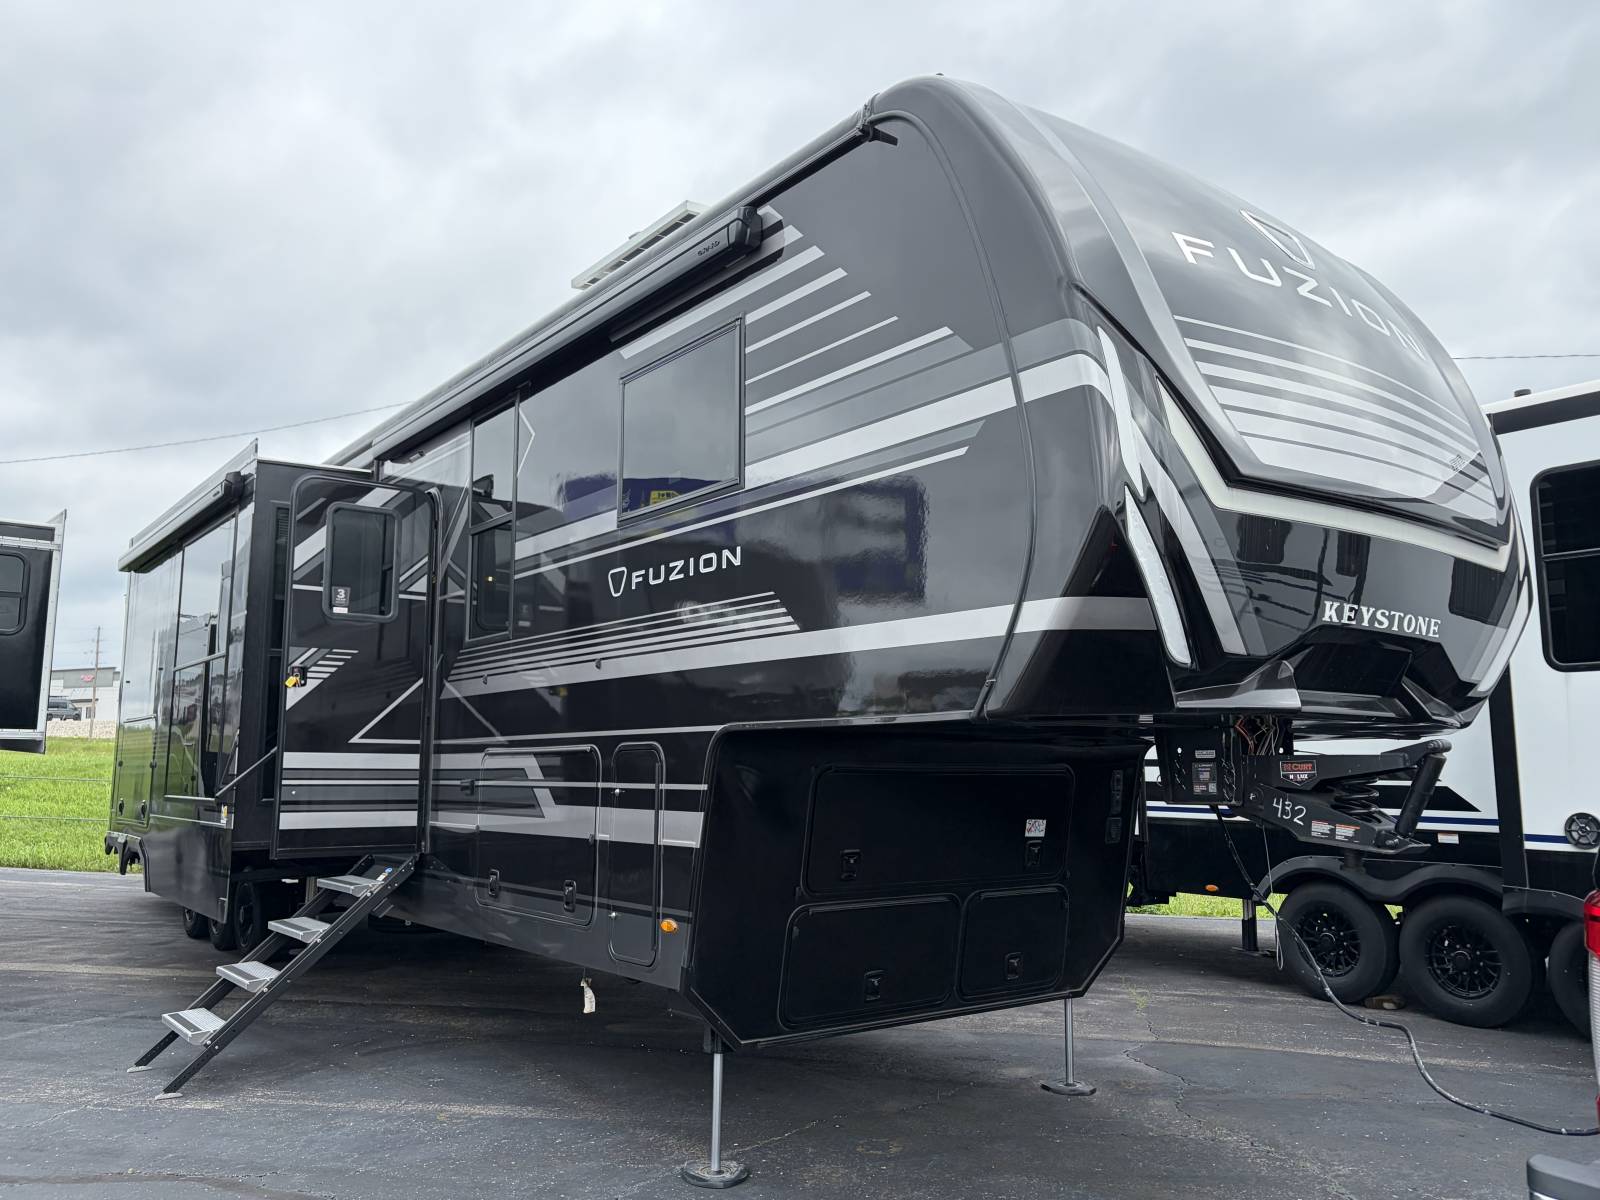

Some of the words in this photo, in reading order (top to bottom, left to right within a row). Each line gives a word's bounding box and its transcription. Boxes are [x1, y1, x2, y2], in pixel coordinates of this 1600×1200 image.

[1171, 231, 1426, 361] FUZION
[631, 546, 741, 590] FUZION
[337, 588, 346, 599] 3
[1322, 600, 1441, 638] KEYSTONE
[1272, 797, 1307, 826] 432
